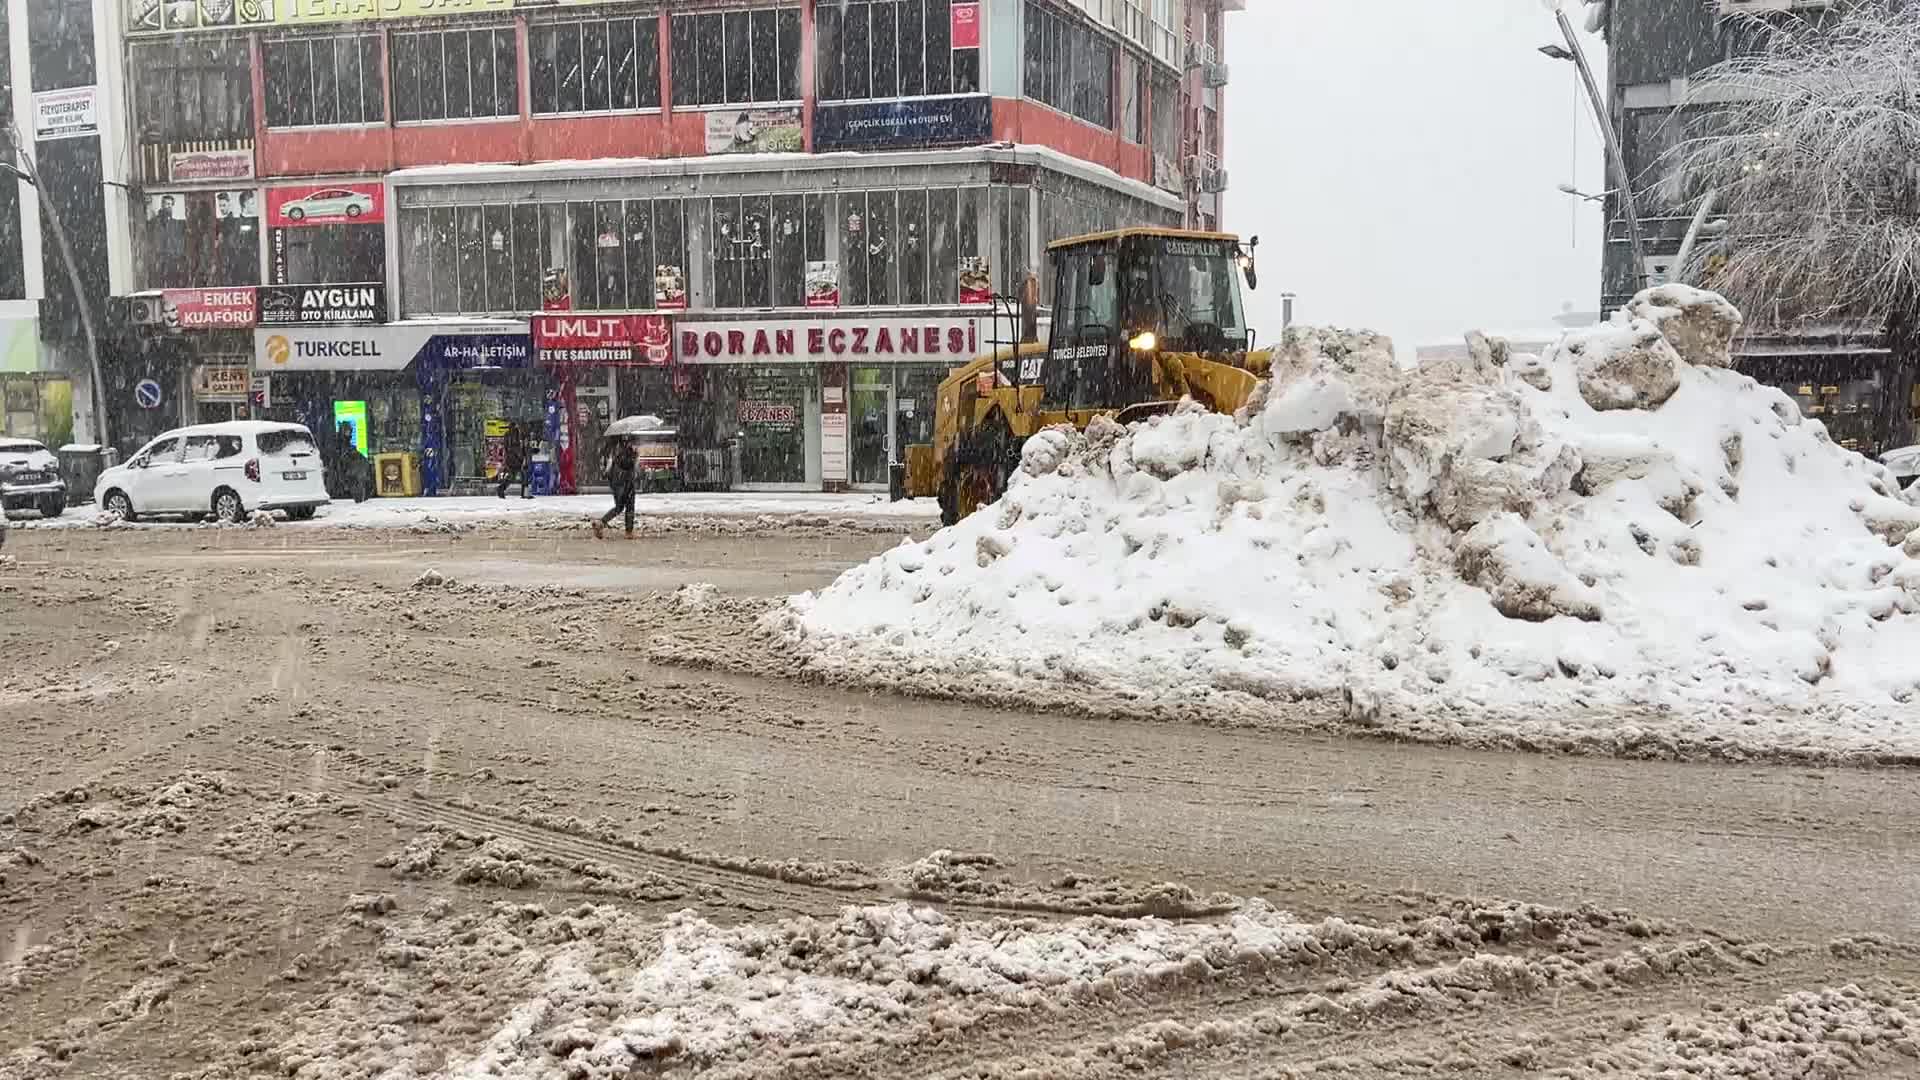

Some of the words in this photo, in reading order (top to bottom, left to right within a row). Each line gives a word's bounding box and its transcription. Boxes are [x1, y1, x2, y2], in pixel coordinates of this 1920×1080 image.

[204, 291, 253, 306] ERKEK
[302, 288, 375, 307] AYGÜN
[184, 309, 254, 324] KUAFÖRÜ
[301, 310, 321, 320] OTO
[324, 308, 375, 320] KİRALAMA
[541, 319, 620, 337] UMUT
[681, 328, 795, 357] BORAN
[807, 318, 977, 355] ECZANESİ
[294, 340, 382, 357] TURKCELL
[444, 345, 479, 357] AR-HA
[481, 343, 526, 359] İLETİŞİM
[540, 350, 553, 360] ET
[554, 350, 569, 360] VE
[570, 348, 632, 361] ŞARKÜTERİ
[1020, 358, 1045, 379] CAT
